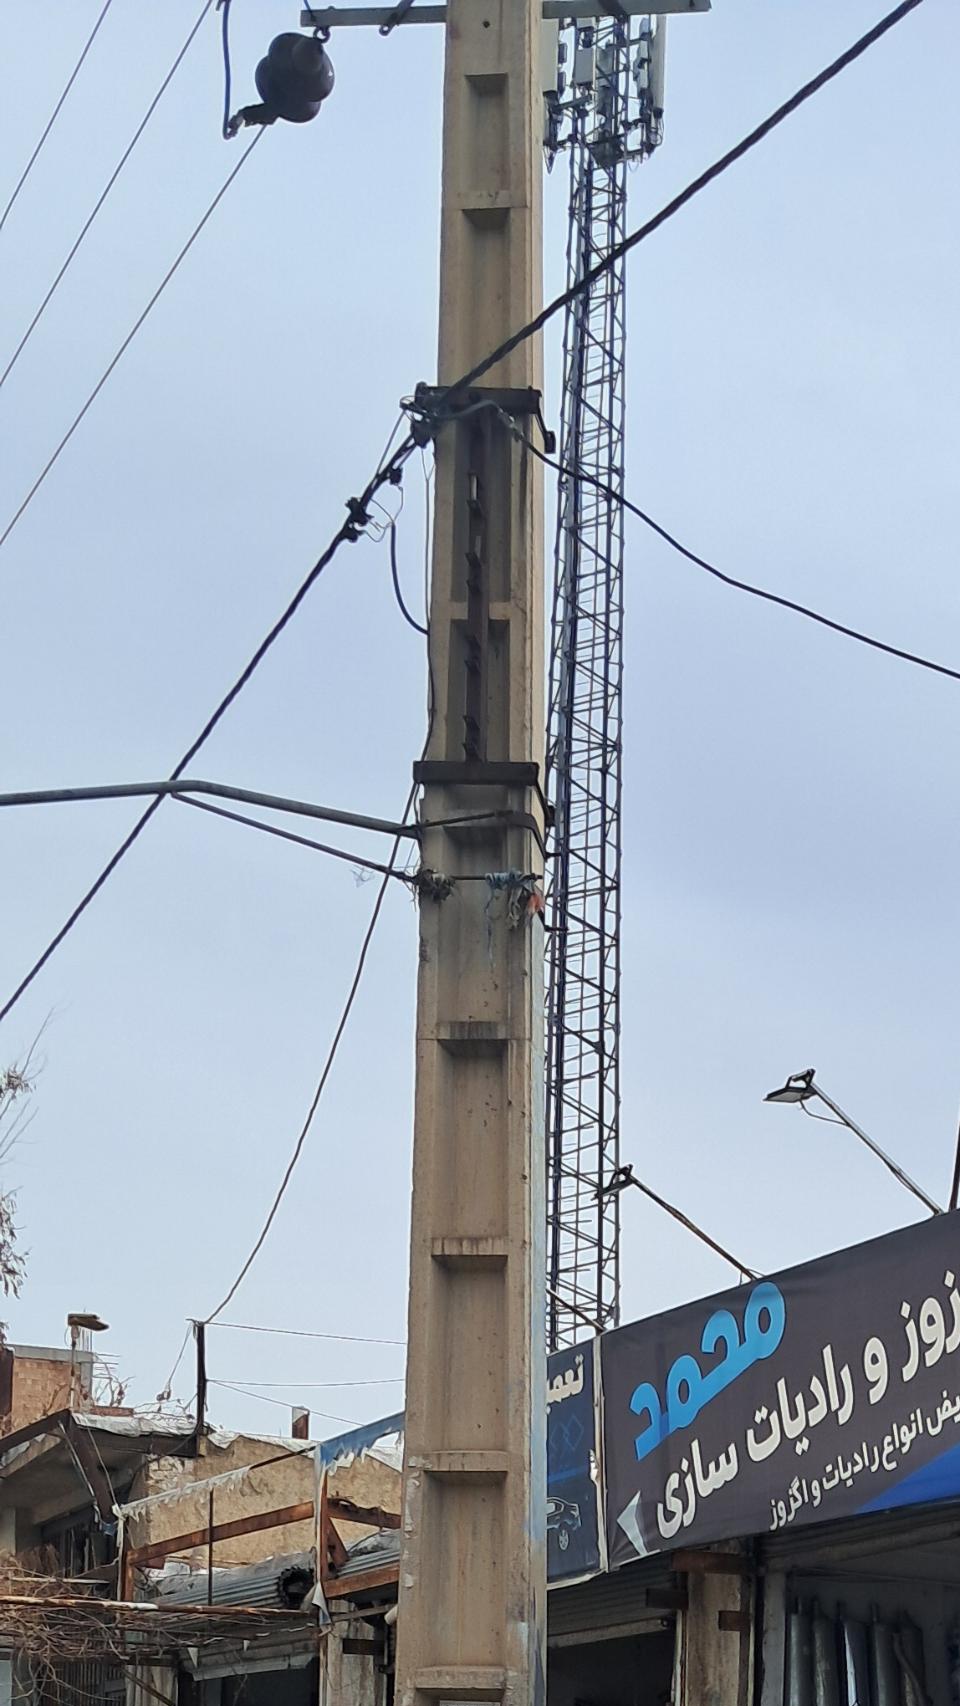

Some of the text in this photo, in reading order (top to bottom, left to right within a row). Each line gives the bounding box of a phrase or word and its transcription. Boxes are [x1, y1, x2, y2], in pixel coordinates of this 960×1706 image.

[630, 1281, 786, 1462] محمد
[746, 1343, 854, 1463] رادیات
[863, 1336, 889, 1405] و
[822, 1441, 880, 1487] رادیات
[881, 1407, 924, 1471] انواع
[656, 1438, 739, 1539] سازی
[769, 1475, 809, 1531] اگزوز
[811, 1476, 821, 1507] و
